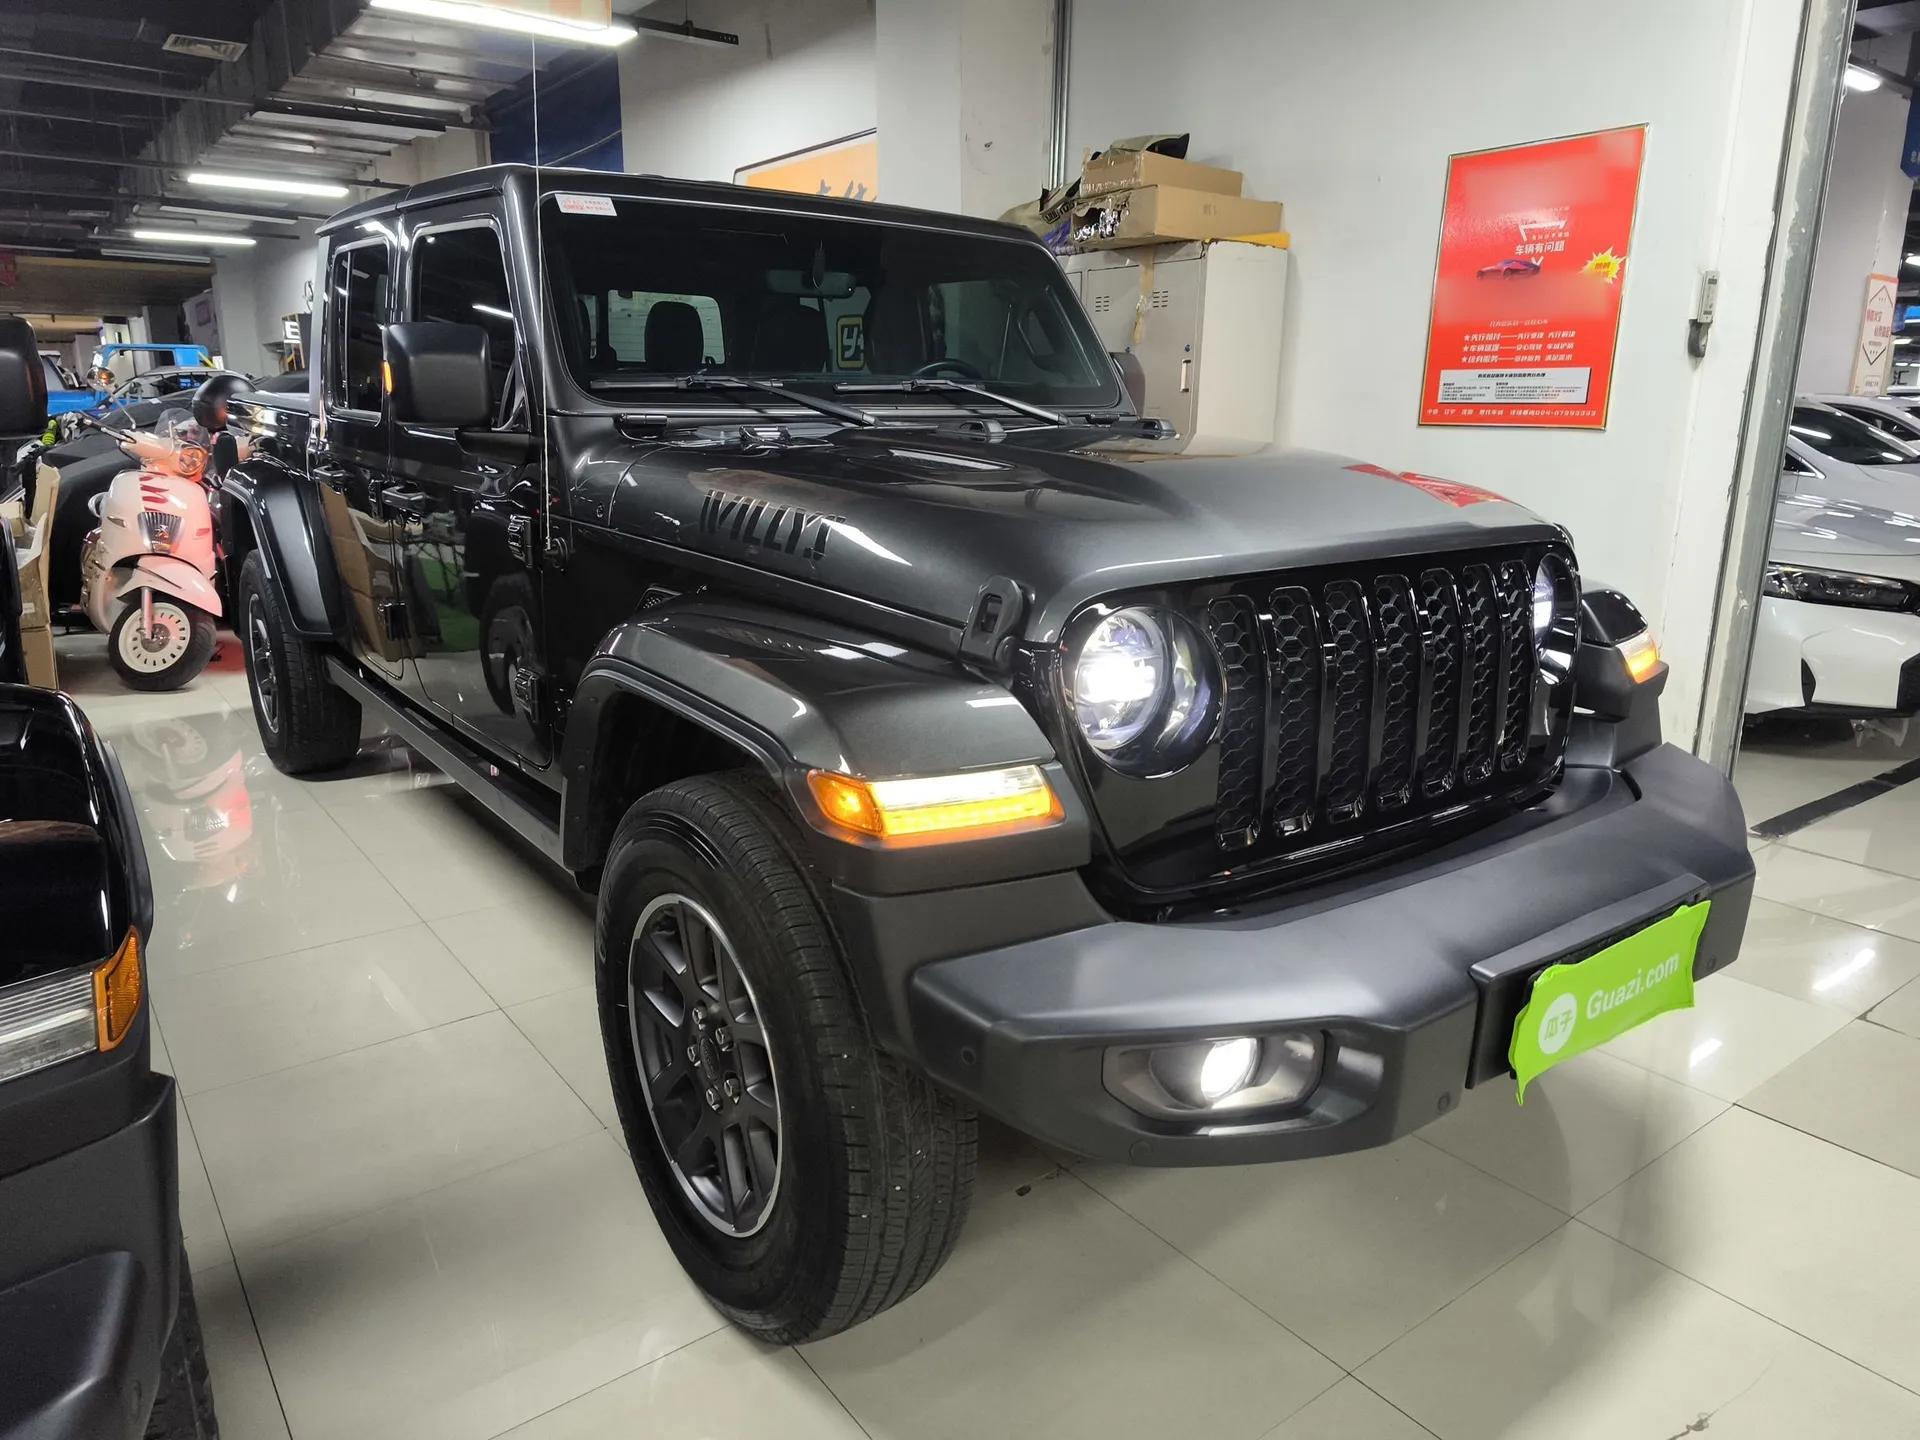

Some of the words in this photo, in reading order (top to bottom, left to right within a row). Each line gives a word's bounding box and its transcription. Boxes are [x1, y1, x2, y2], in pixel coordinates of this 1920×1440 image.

[1515, 240, 1566, 257] 车辆有问题
[1586, 953, 1680, 1020] Guazi.com
[1544, 1006, 1574, 1041] 瓜子
